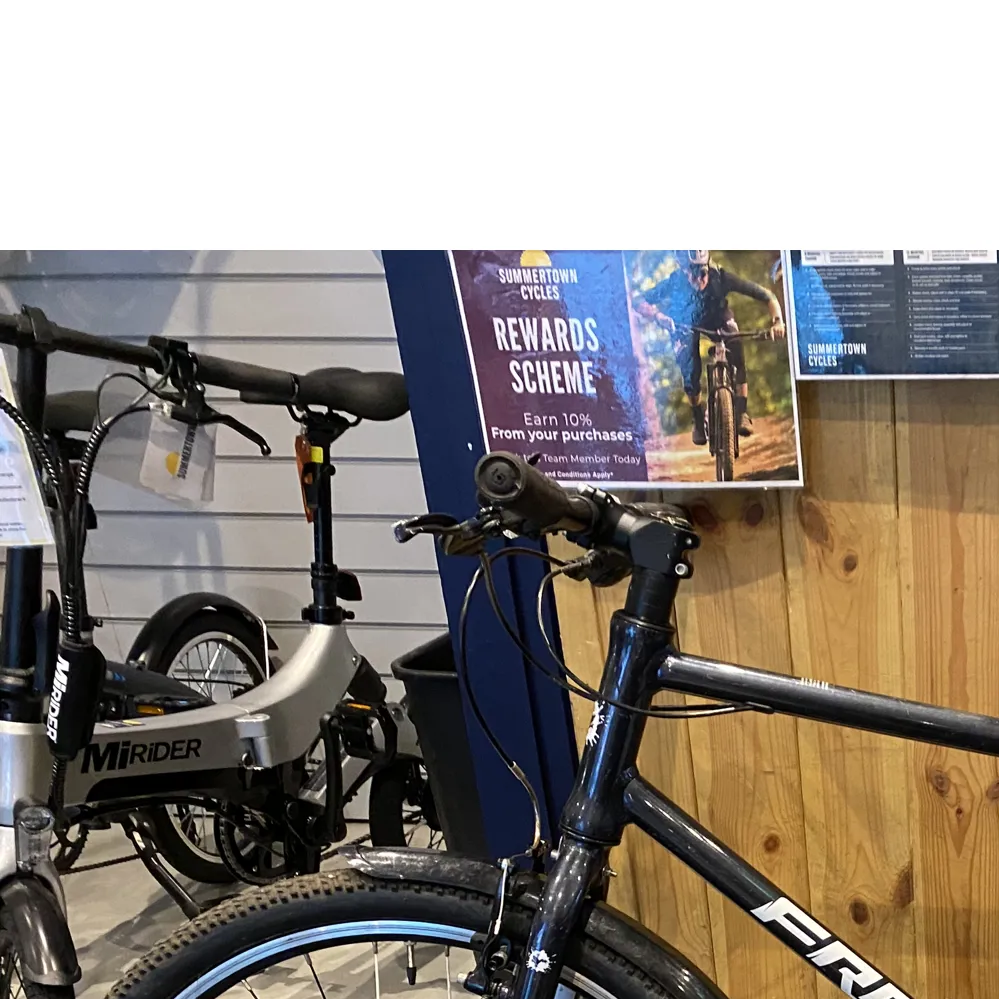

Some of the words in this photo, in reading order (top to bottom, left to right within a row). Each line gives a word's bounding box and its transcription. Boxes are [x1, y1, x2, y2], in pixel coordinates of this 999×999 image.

[498, 268, 578, 284] SUMMERTOWN
[520, 285, 560, 300] CYCLES
[492, 317, 599, 352] REWARDS
[807, 343, 867, 355] SUMMERTOWN
[808, 355, 838, 367] CYCLES
[509, 360, 597, 394] SCHEME
[523, 412, 558, 426] Earn
[562, 413, 593, 427] 10%
[491, 427, 525, 440] From
[527, 430, 558, 443] your
[561, 428, 633, 443] purchases
[542, 454, 568, 464] Team
[570, 455, 610, 464] Member
[613, 454, 641, 466] Today
